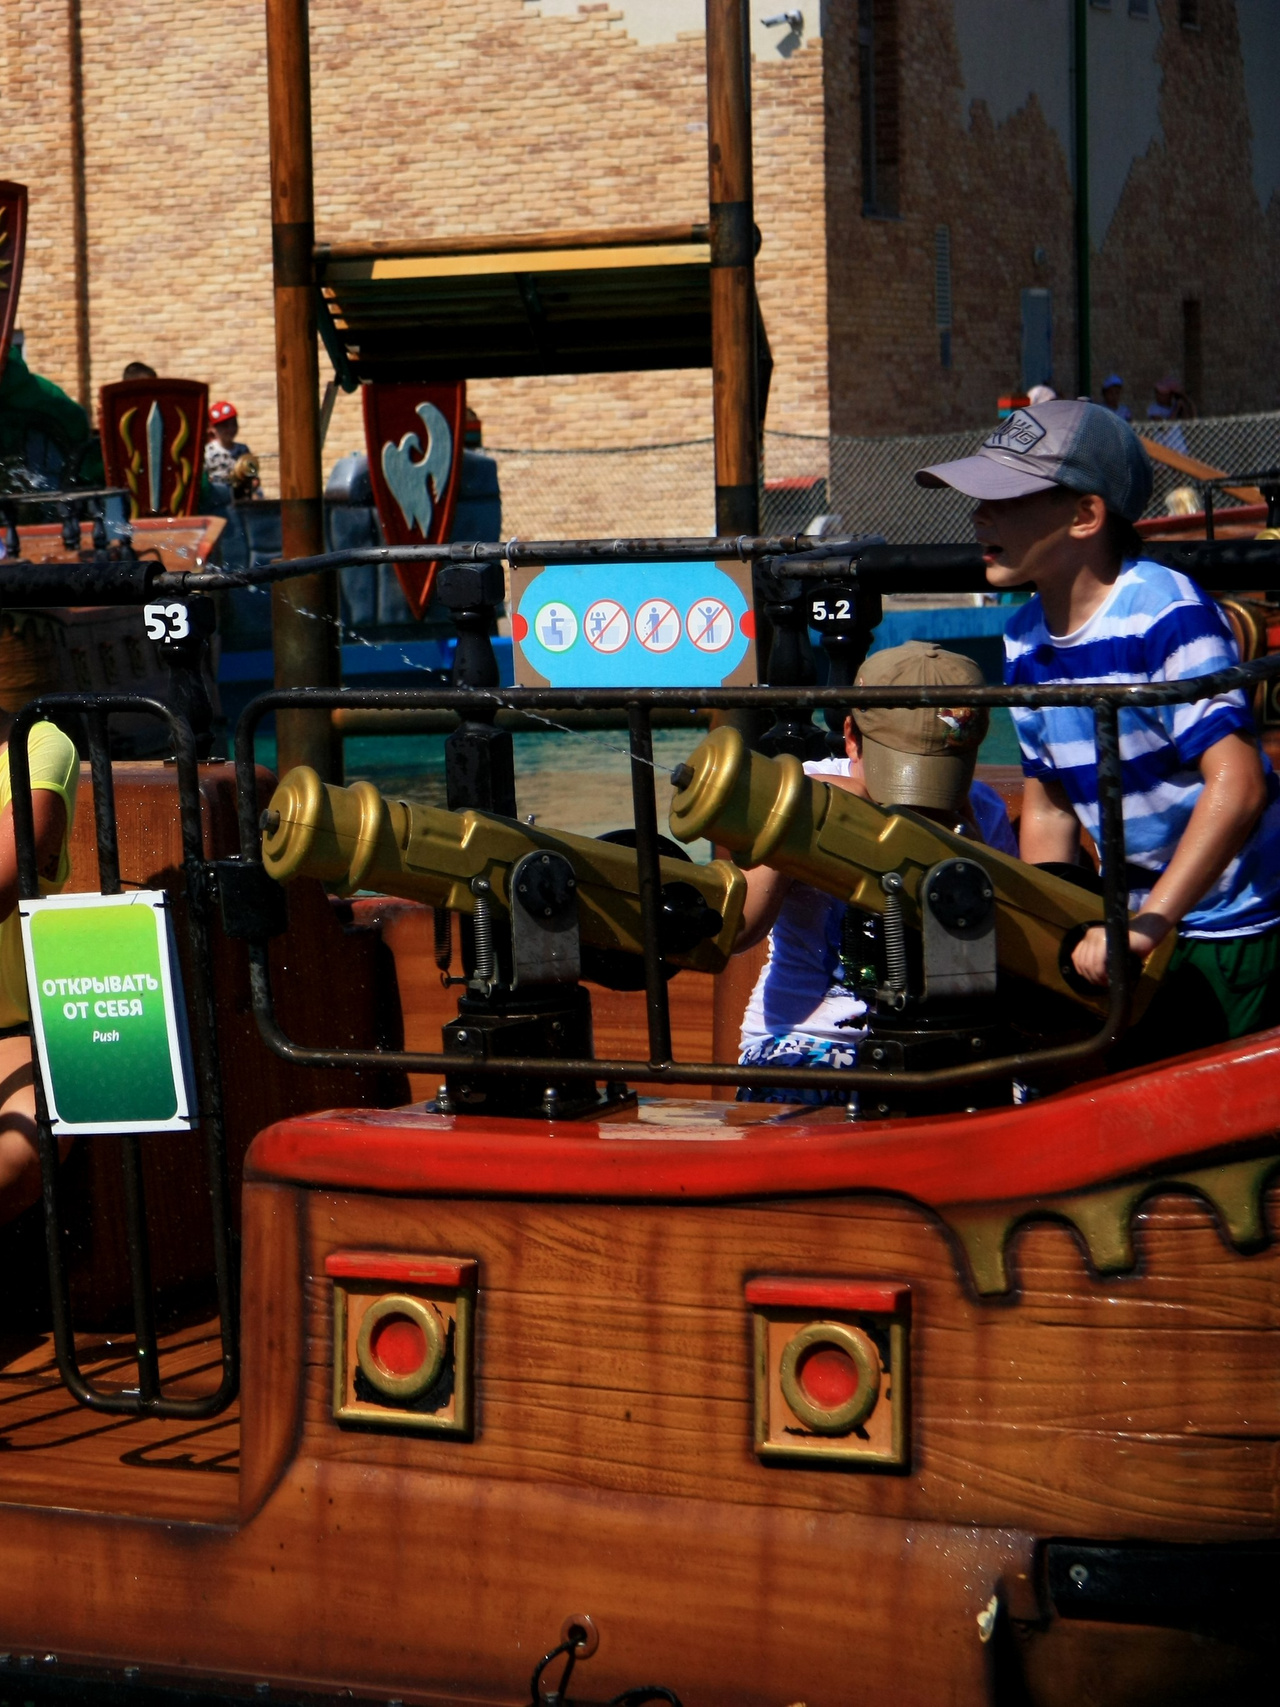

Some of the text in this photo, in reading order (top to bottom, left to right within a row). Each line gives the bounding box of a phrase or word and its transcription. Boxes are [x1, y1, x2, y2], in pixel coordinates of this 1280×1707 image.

[812, 600, 851, 621] 5.2
[42, 973, 159, 997] ОТКРЫВАТЬ
[62, 999, 143, 1020] ОТ СЕБЯ
[92, 1030, 120, 1043] Push
